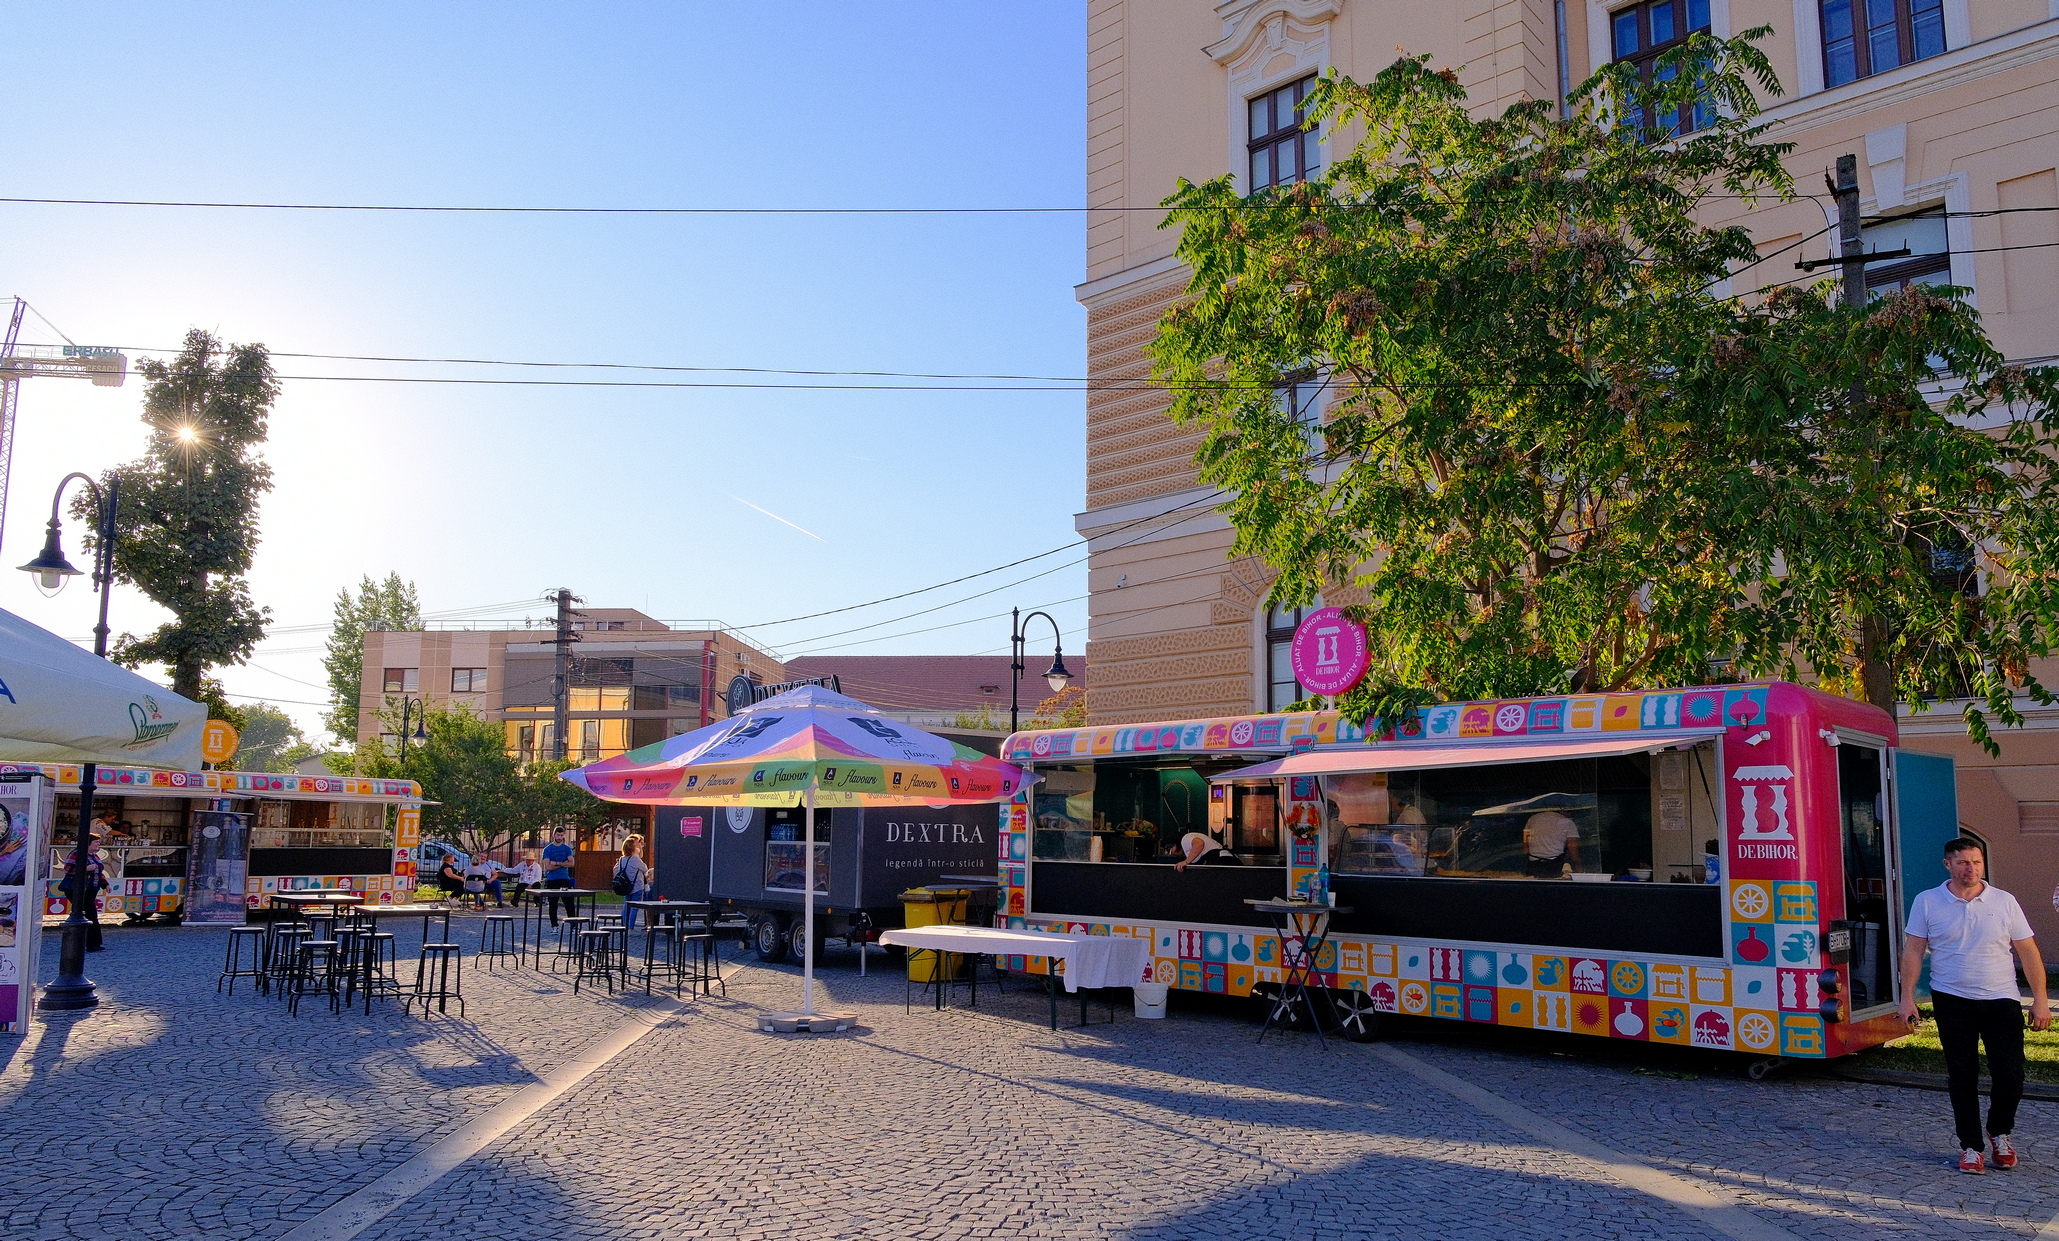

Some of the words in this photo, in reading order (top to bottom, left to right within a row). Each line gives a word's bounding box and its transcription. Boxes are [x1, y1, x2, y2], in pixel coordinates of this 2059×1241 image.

[1302, 615, 1321, 634] BIHOR
[1296, 635, 1304, 646] DE
[1353, 631, 1362, 657] BIHOR
[1295, 647, 1304, 672] ALUAT
[1339, 662, 1357, 685] ALUAT
[1305, 676, 1326, 690] BIHOR
[1327, 681, 1338, 689] DE
[886, 822, 985, 844] DEXTRA
[1738, 844, 1756, 859] DE
[885, 859, 923, 869] legendă
[927, 858, 955, 868] într-o
[959, 859, 984, 868] sticlă
